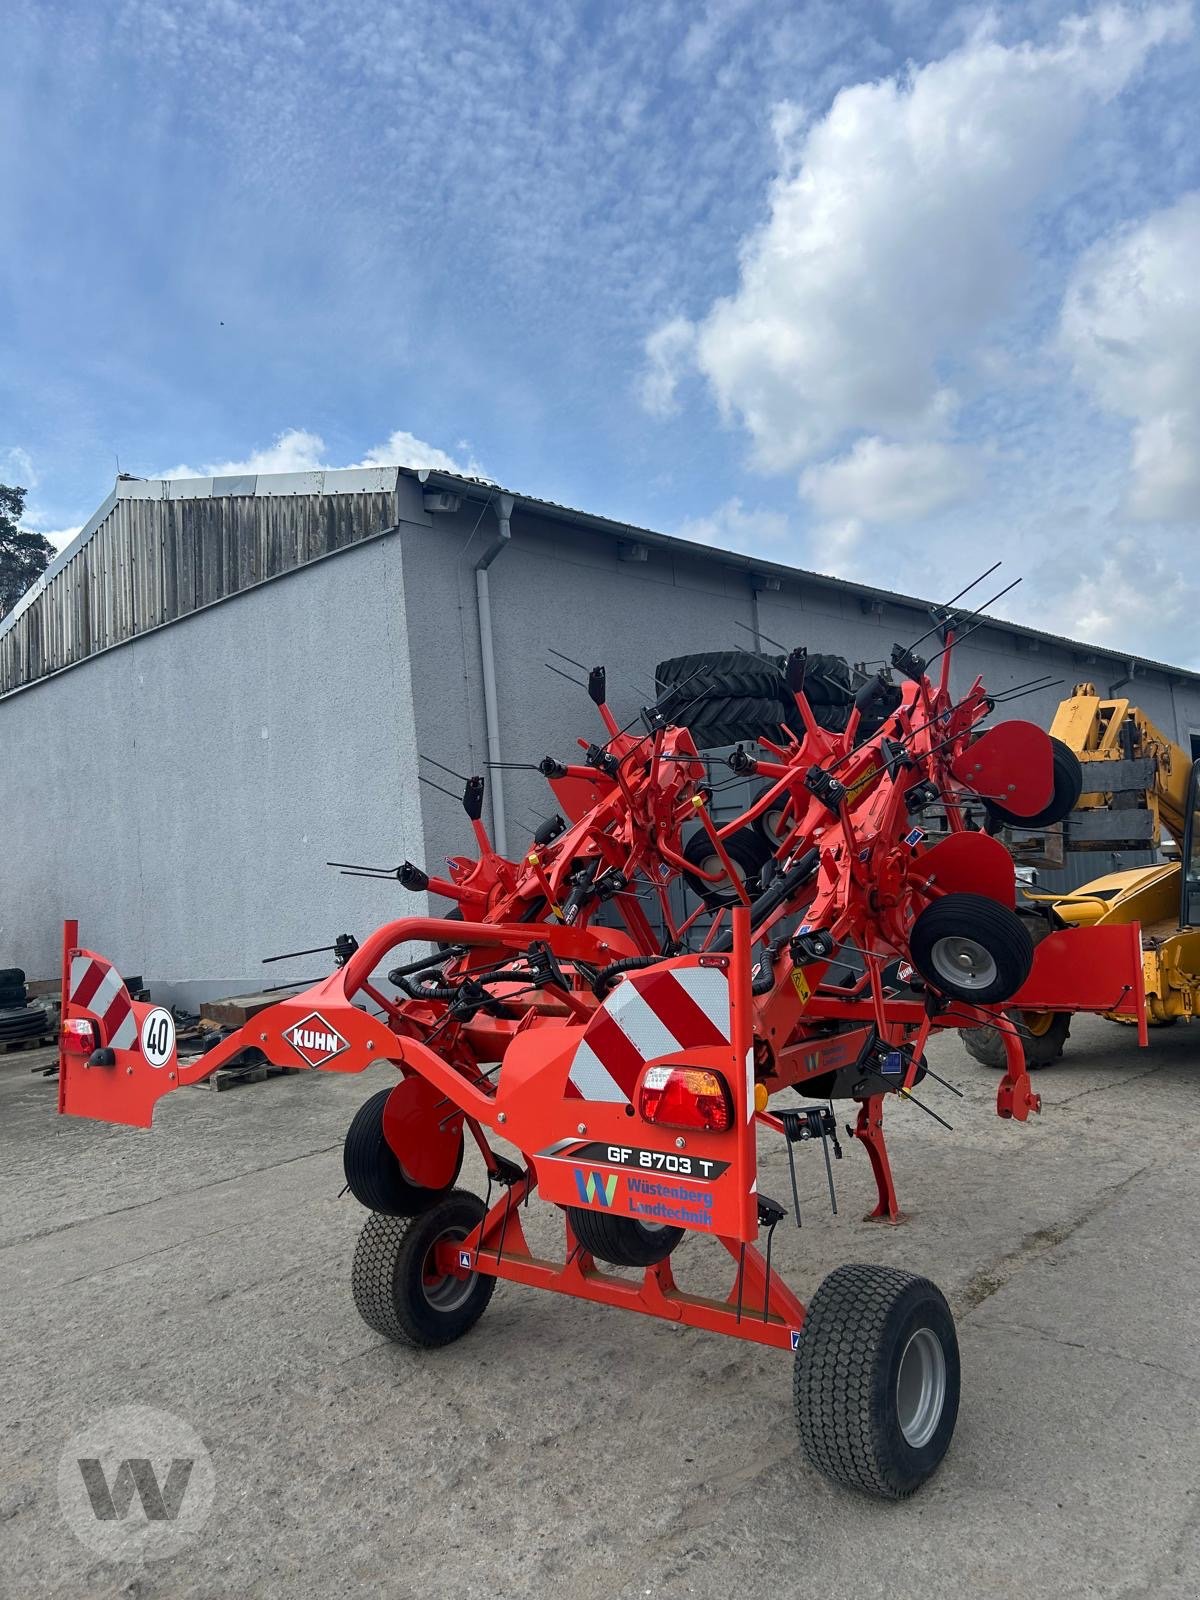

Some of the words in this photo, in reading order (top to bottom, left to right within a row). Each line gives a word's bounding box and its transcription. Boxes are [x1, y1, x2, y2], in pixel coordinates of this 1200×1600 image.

[146, 1017, 169, 1056] 40
[292, 1028, 338, 1052] KUHN
[607, 1146, 632, 1163] GF
[639, 1152, 692, 1174] 8703
[699, 1160, 713, 1177] T
[627, 1177, 713, 1208] Wüstenberg
[629, 1197, 713, 1226] Landtechnik
